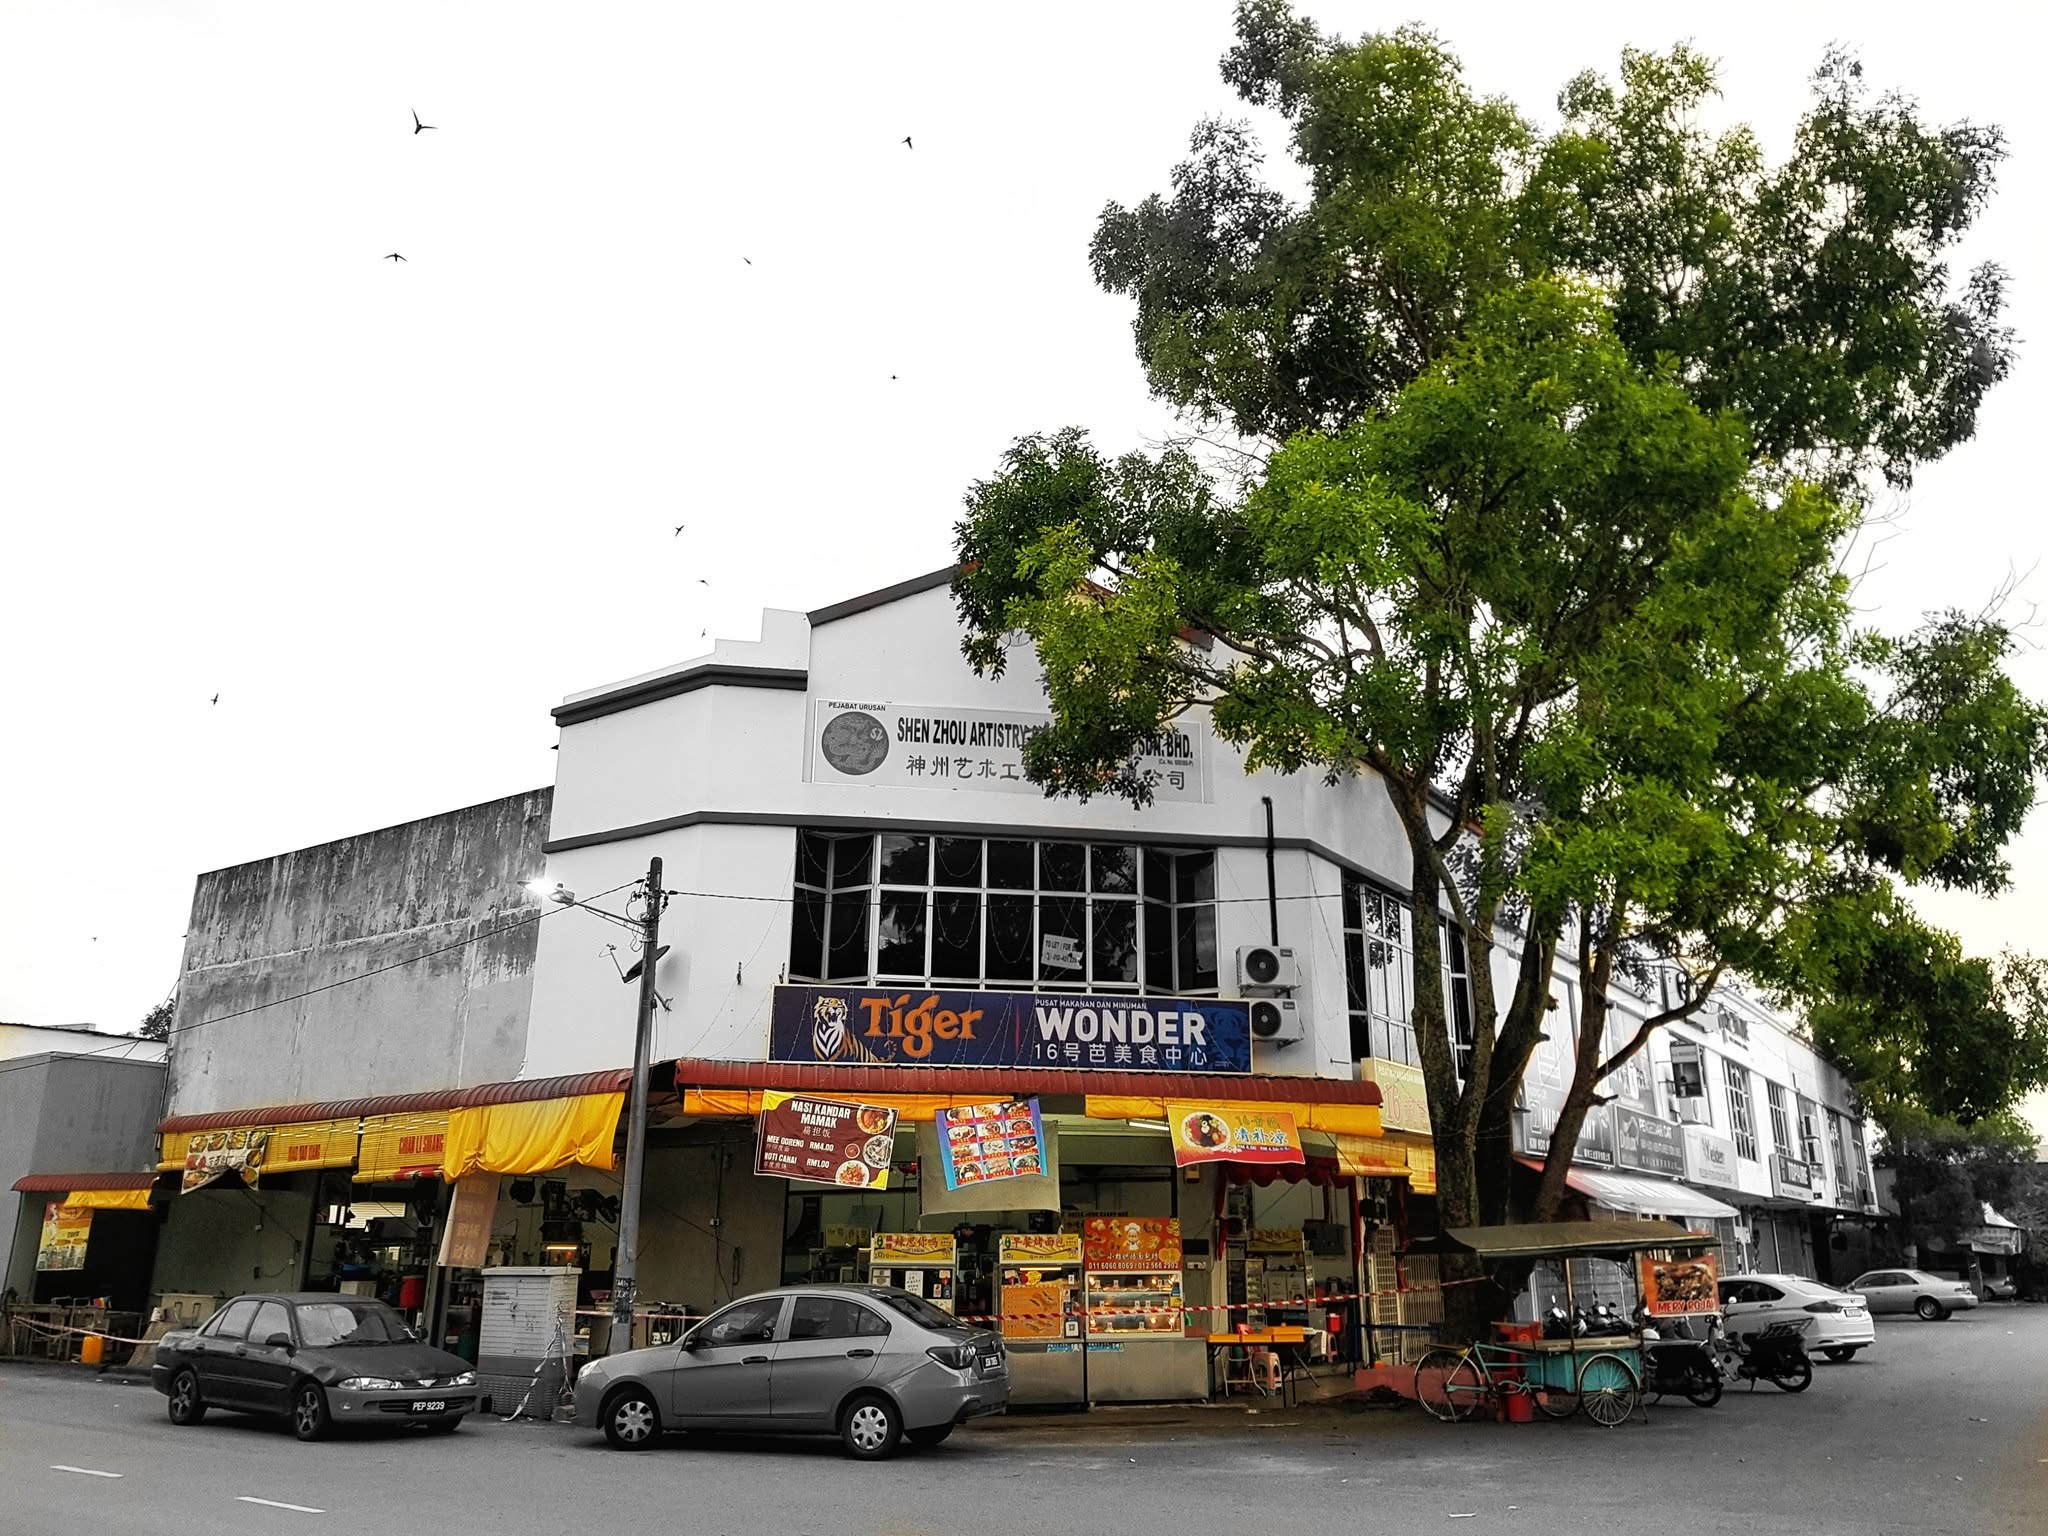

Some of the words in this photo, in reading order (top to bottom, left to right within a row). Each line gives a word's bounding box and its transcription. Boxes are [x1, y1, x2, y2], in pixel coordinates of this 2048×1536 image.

[828, 702, 857, 710] PEJABAT
[859, 704, 886, 712] URUSAN
[897, 716, 930, 743] SHEN
[932, 719, 967, 746] ZHOU
[969, 721, 1026, 749] ARTISTRY
[1166, 734, 1193, 759] BHD.
[1035, 999, 1058, 1008] PUSAT
[1060, 1000, 1095, 1009] MAKANAN
[1113, 1002, 1147, 1011] MINUMAN
[859, 993, 984, 1058] Tiger
[1036, 1007, 1206, 1046] WONDER
[1034, 1043, 1208, 1066] 16号芭美食中心
[791, 1100, 813, 1113] NASI
[814, 1104, 851, 1119] KANDAR
[800, 1113, 838, 1129] MAMAK
[766, 1135, 780, 1144] MEE
[780, 1137, 805, 1148] GORENG
[809, 1141, 834, 1152] RM4.00
[764, 1152, 778, 1161] ROTI
[778, 1154, 797, 1164] CANAI
[806, 1158, 830, 1169] RM1.00
[1088, 1262, 1100, 1270] 011
[1657, 1301, 1686, 1313] MERY
[1687, 1298, 1715, 1312] ROJA
[412, 1401, 427, 1411] PEP
[426, 1401, 445, 1411] 9239
